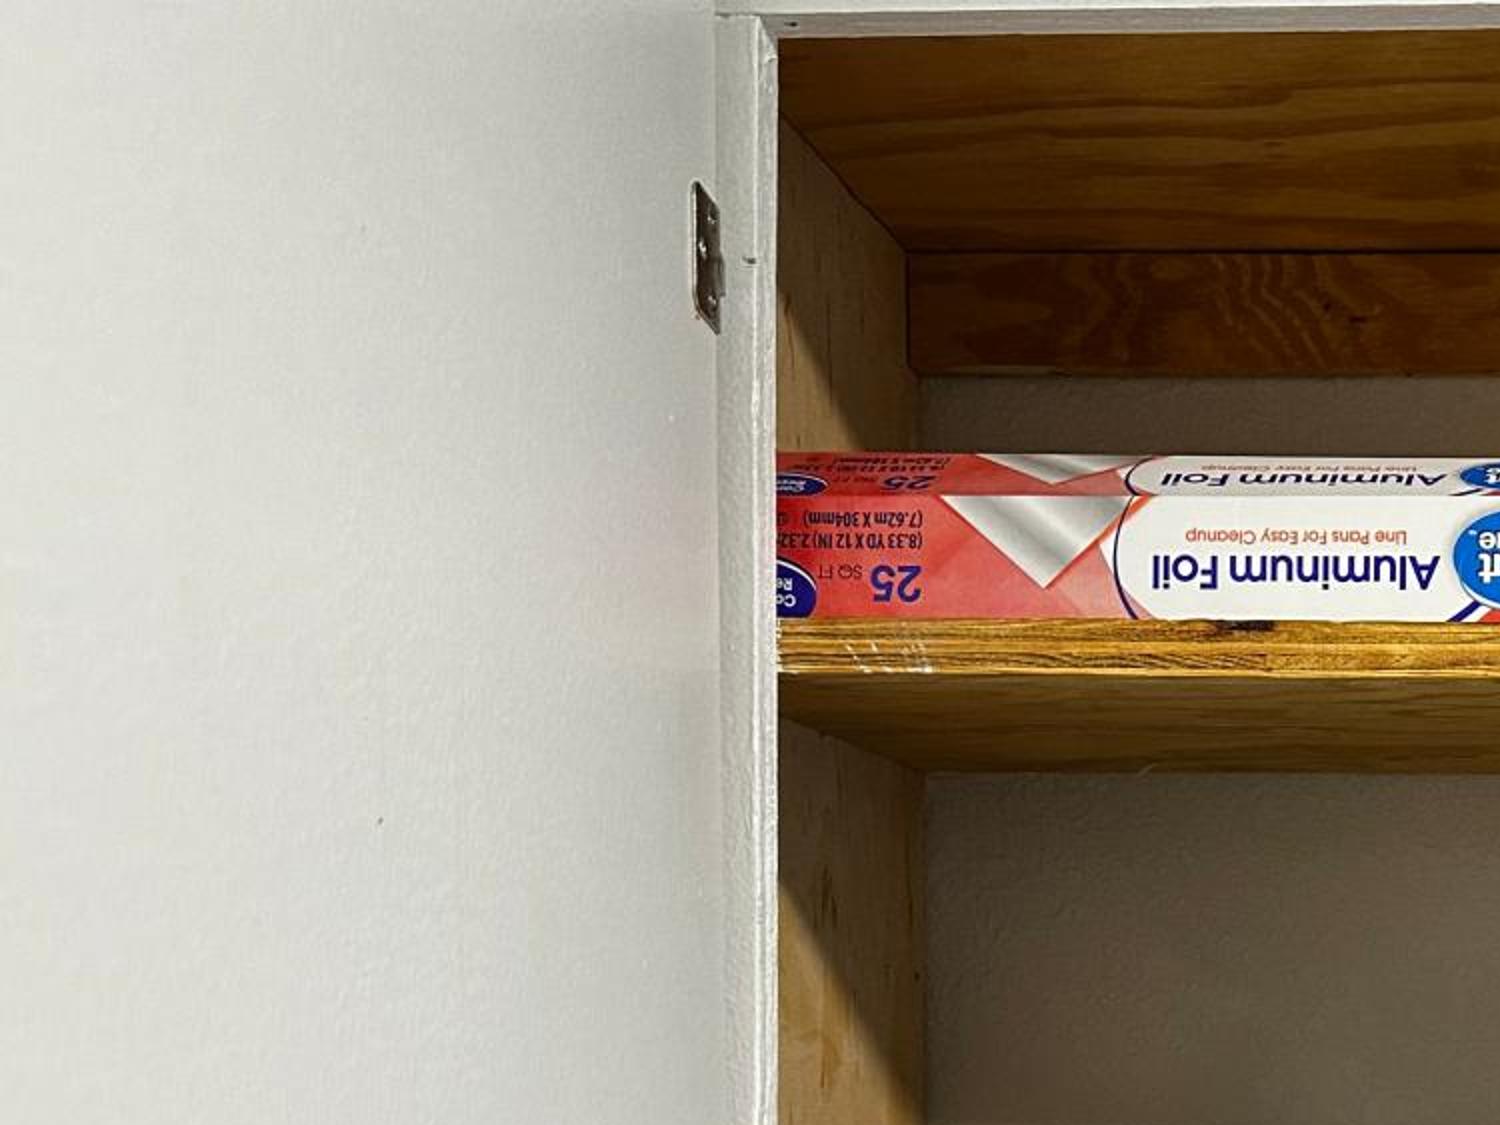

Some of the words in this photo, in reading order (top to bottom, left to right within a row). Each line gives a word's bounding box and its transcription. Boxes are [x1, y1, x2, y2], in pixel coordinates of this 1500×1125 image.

[883, 475, 938, 490] 25
[1161, 472, 1229, 486] Foil
[1239, 472, 1448, 486] Aluminum
[863, 511, 871, 527] X
[874, 509, 923, 528] (7.62m
[813, 532, 832, 550] IN)
[837, 533, 851, 549] 12
[855, 533, 864, 549] X
[867, 533, 886, 549] YD
[887, 532, 923, 550] (8.33
[1185, 528, 1257, 545] Cleanup
[1260, 528, 1299, 545] Easy
[1302, 529, 1328, 545] For
[1331, 529, 1370, 545] Pans
[1375, 529, 1407, 545] Line
[819, 564, 833, 579] FT
[837, 564, 863, 579] SQ
[1152, 554, 1219, 590] Foil
[1229, 554, 1440, 590] Aluminum
[870, 565, 922, 603] 25
